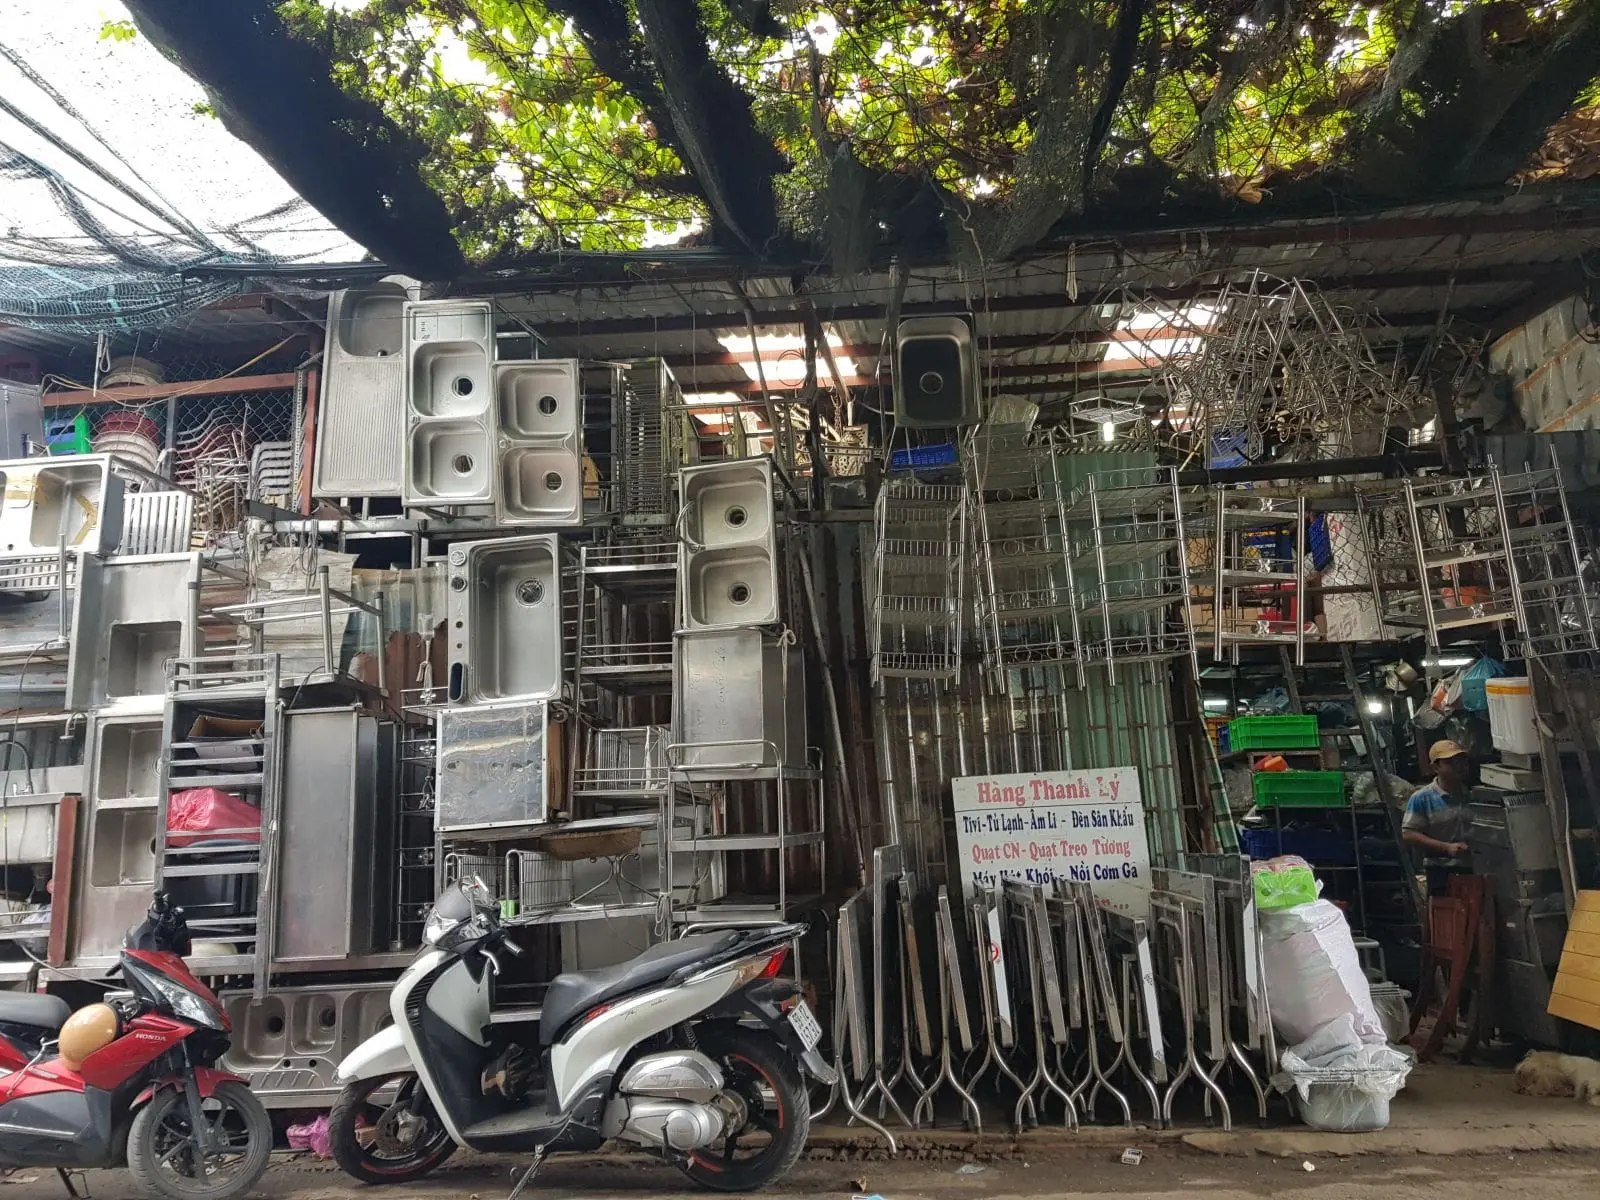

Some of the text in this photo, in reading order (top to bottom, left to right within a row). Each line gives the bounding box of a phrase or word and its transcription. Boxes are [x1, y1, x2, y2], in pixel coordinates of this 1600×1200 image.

[977, 781, 1026, 807] Hàng
[1029, 777, 1091, 801] Thanh
[986, 812, 1000, 832] Tủ
[1001, 813, 1024, 835] Lạnh
[1047, 811, 1057, 829] Li
[1071, 810, 1090, 828] Đèn
[1091, 809, 1109, 828] Sân
[972, 844, 1000, 865] Quạt
[1002, 842, 1020, 859] CN
[1029, 841, 1058, 862] Quạt
[1060, 840, 1088, 857] Treo
[1092, 835, 1131, 858] Tường
[1069, 861, 1091, 881] Nồi
[1093, 863, 1120, 881] Cơm
[135, 1033, 167, 1041] HONDA
